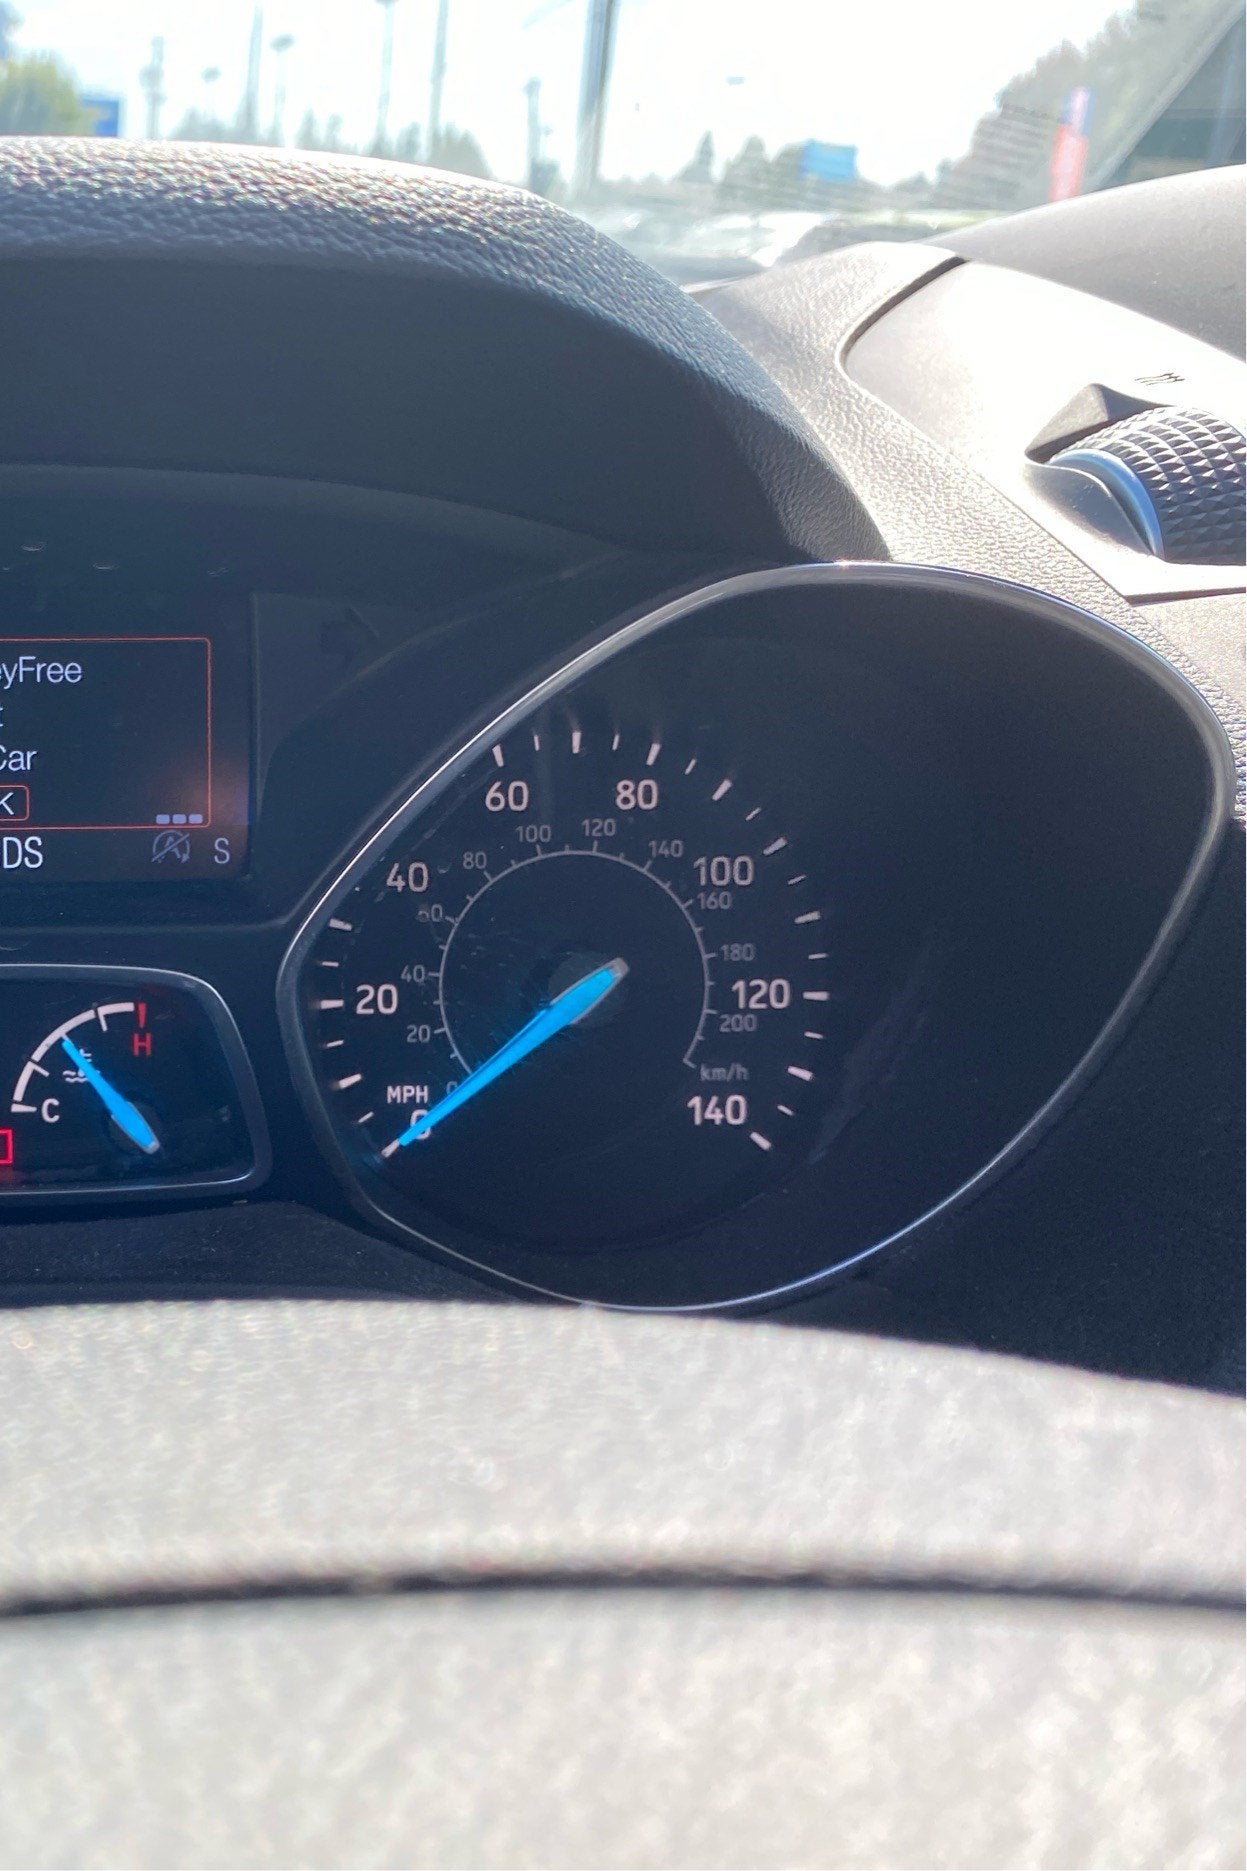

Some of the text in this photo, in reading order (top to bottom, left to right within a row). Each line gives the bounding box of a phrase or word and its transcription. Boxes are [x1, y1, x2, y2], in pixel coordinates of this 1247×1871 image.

[484, 780, 529, 812] 60
[615, 779, 658, 811] 80
[515, 823, 552, 844] 100
[581, 818, 617, 837] 120
[213, 837, 231, 864] S
[462, 850, 488, 870] 80
[649, 840, 684, 859] 140
[386, 861, 429, 893] 40
[693, 855, 754, 886] 100
[696, 891, 733, 910] 160
[720, 942, 755, 962] 180
[400, 964, 426, 985] 40
[356, 983, 398, 1015] 20
[731, 978, 791, 1010] 120
[406, 1024, 431, 1043] 20
[719, 1013, 758, 1033] 200
[132, 1032, 152, 1056] H
[699, 1062, 749, 1082] km/h
[386, 1084, 429, 1104] MPH
[41, 1098, 60, 1123] C
[687, 1094, 748, 1126] 140
